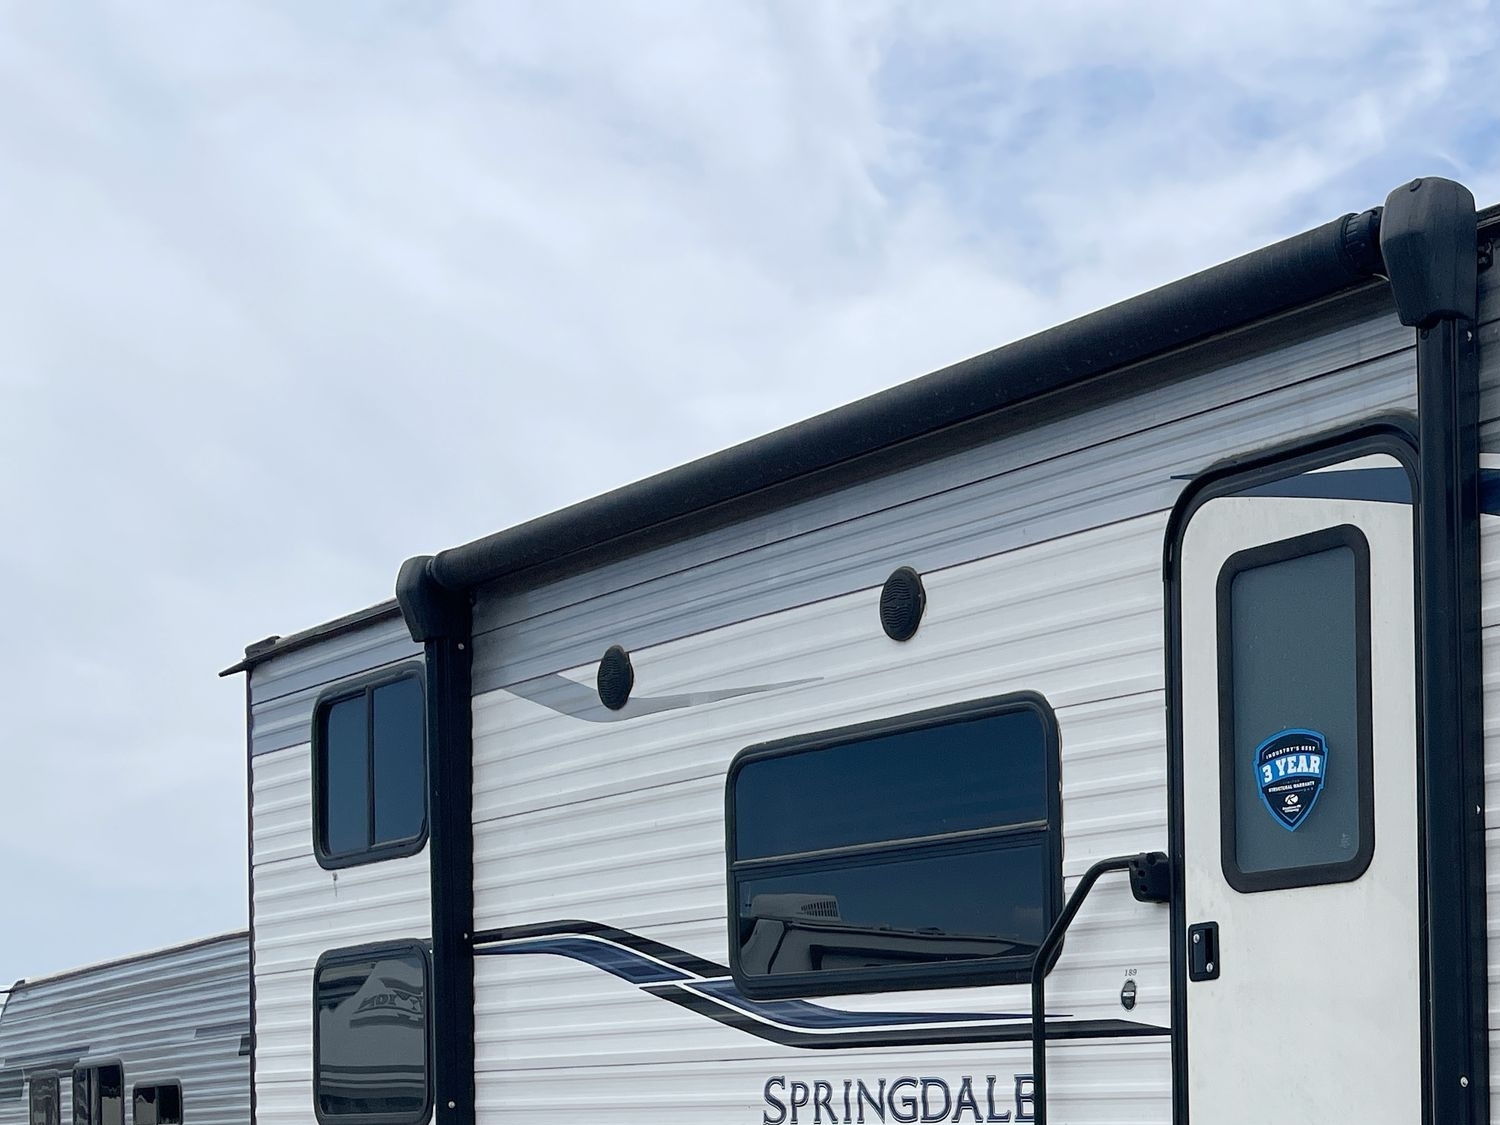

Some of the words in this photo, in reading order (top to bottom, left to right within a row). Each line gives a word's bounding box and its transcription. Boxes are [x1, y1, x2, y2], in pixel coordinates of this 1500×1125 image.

[1262, 764, 1273, 783] 3
[1275, 755, 1321, 777] YEAR
[763, 1075, 1034, 1125] SPRINGDALE
